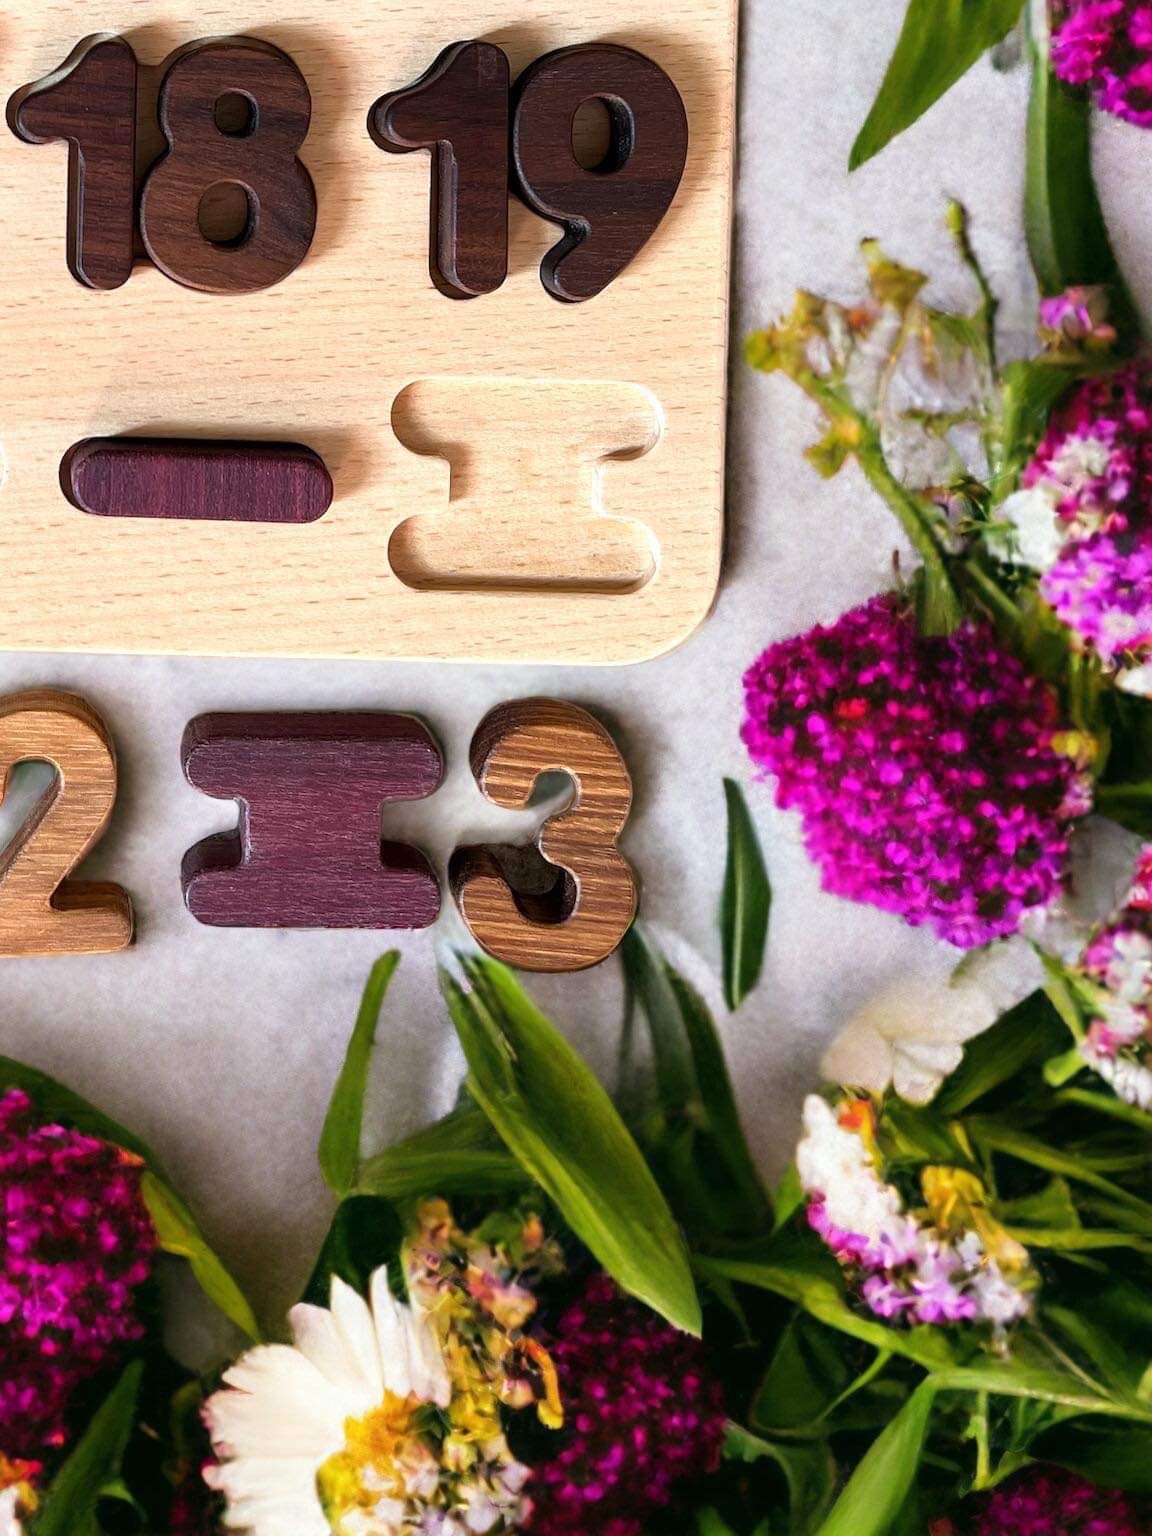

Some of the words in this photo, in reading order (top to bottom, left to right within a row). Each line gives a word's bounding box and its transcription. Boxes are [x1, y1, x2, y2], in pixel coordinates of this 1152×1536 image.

[6, 32, 318, 295] 18
[366, 39, 688, 304] 19
[450, 696, 639, 973] 3
